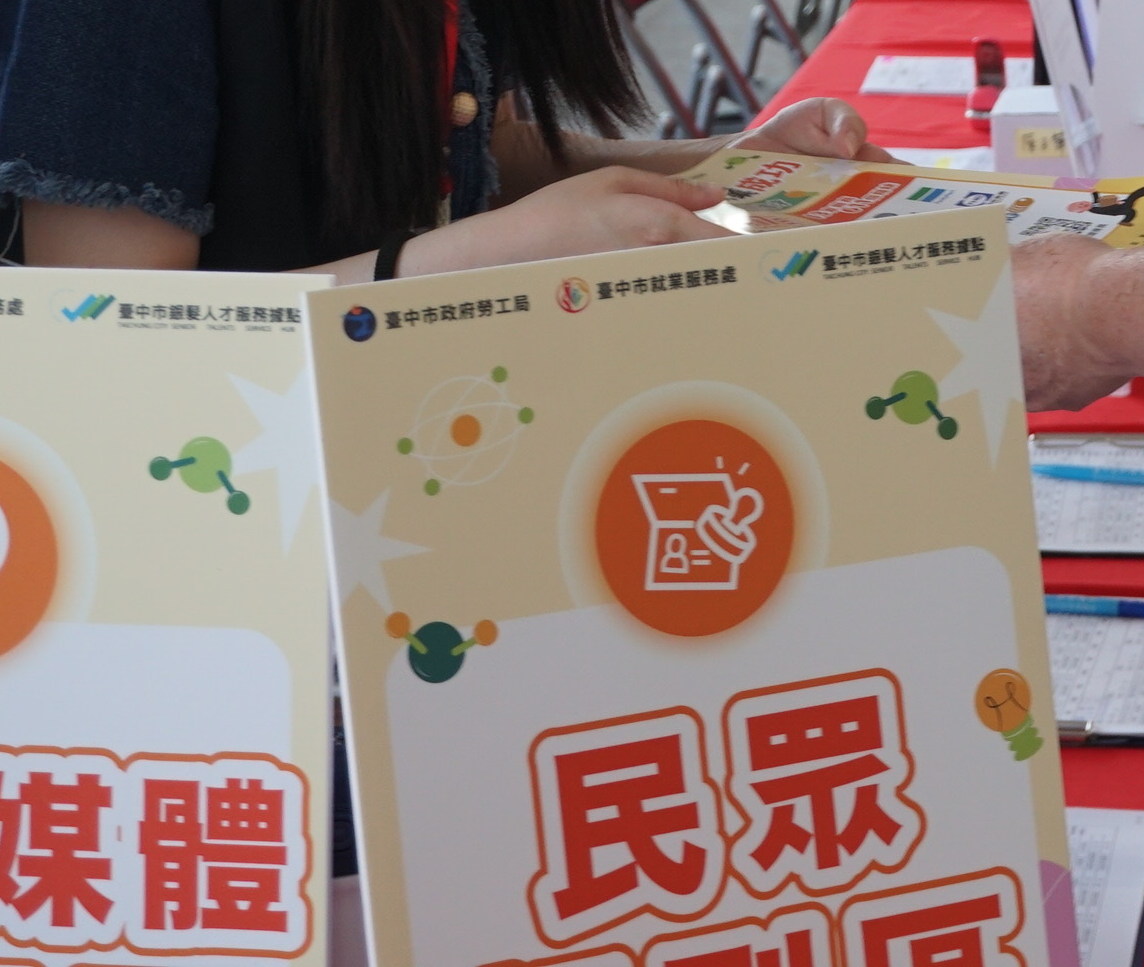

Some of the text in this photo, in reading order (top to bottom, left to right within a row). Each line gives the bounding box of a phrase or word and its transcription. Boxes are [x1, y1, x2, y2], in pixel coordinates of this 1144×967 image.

[384, 294, 531, 330] 臺中市政府勞工局
[596, 266, 738, 300] 臺中市就業服務處
[0, 771, 288, 932] 媒體
[553, 695, 903, 920] 民眾
